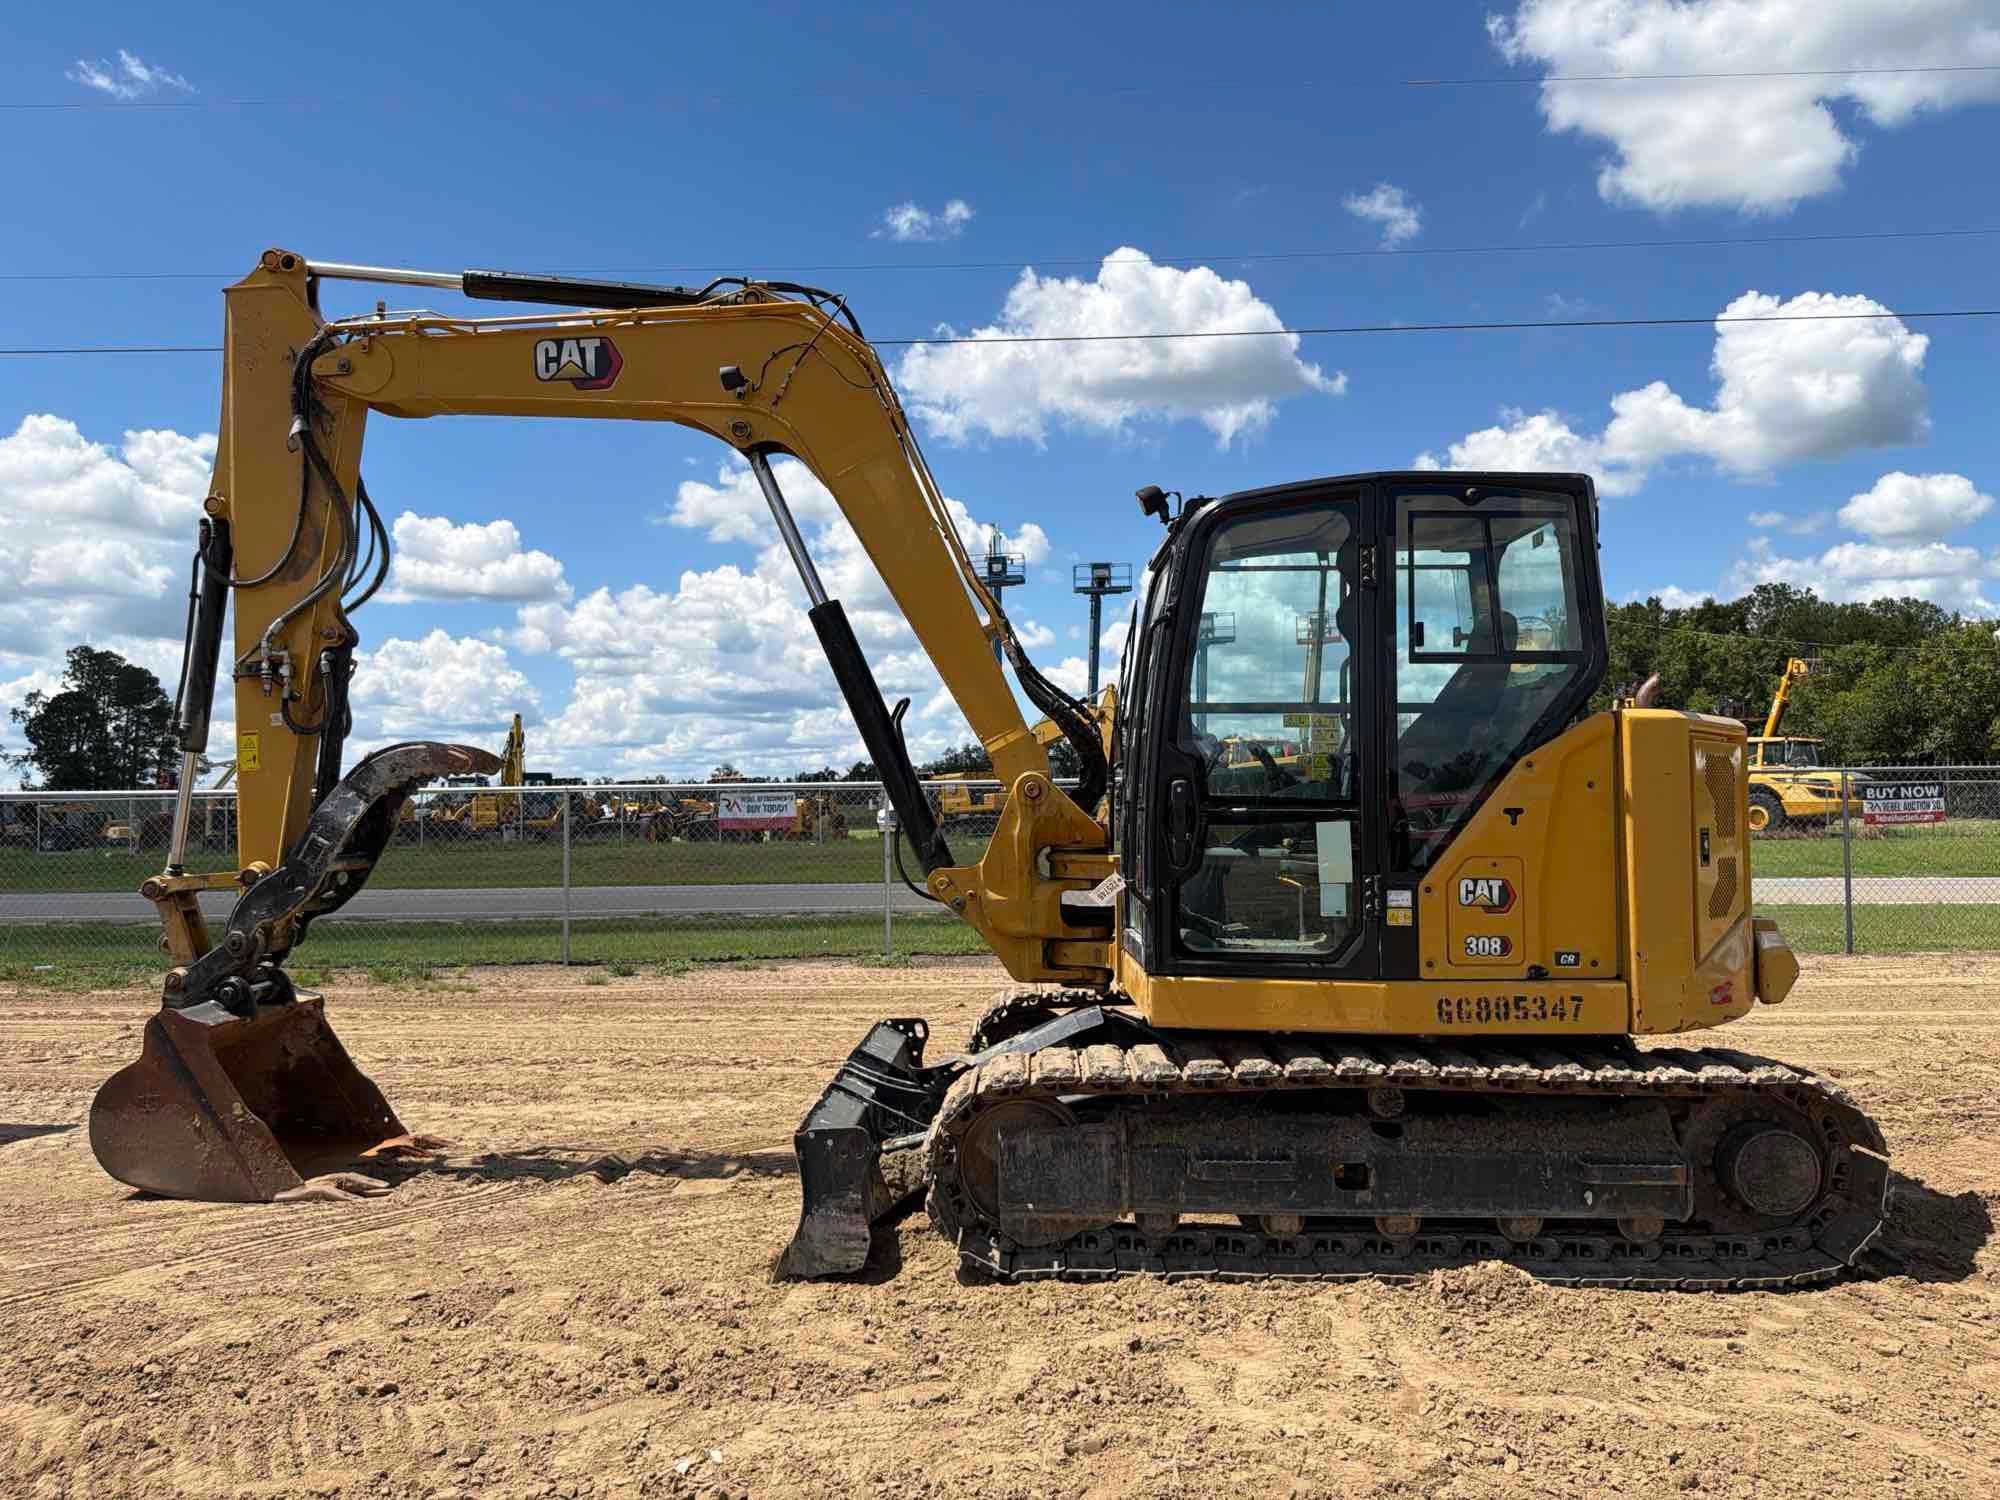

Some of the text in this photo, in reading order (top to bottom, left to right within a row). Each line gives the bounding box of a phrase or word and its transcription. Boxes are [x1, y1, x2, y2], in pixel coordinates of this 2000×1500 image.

[536, 338, 601, 381] CAT
[1866, 785, 1939, 799] BUY NOW
[1459, 878, 1503, 906] CAT
[1465, 936, 1502, 956] 308
[1559, 954, 1575, 965] CR
